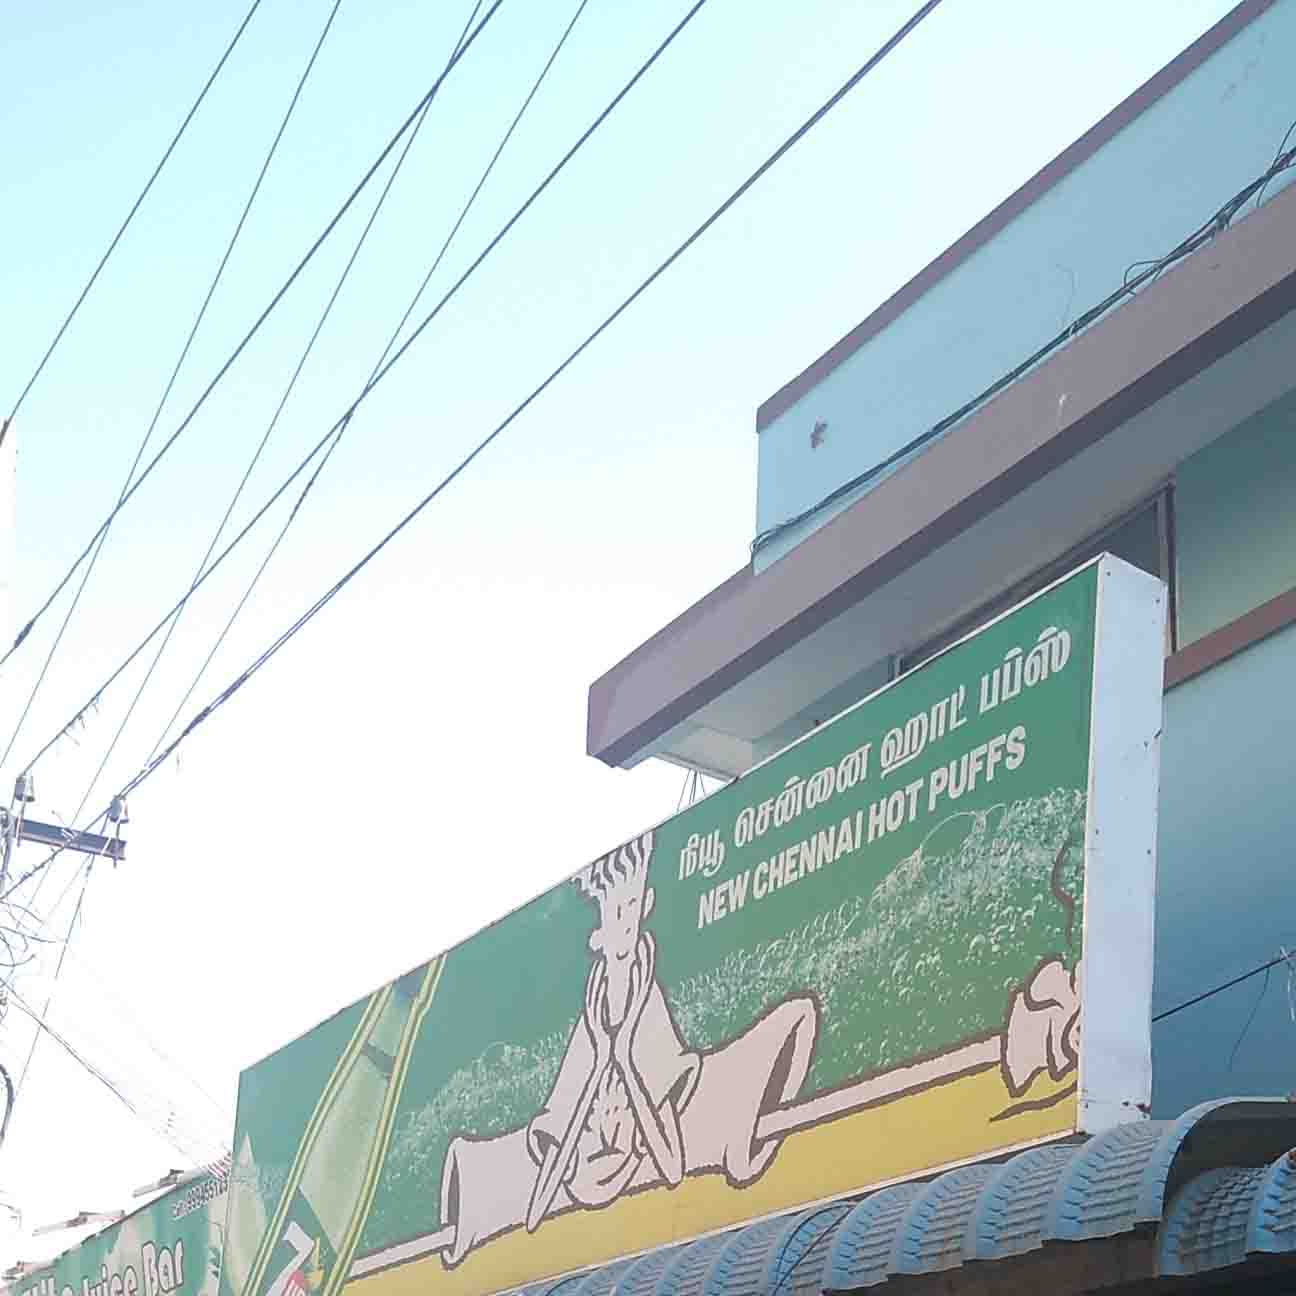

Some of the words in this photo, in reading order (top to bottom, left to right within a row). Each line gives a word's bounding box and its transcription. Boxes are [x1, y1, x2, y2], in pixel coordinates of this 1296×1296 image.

[698, 873, 752, 928] NEW
[752, 810, 864, 900] CHENNAI
[868, 779, 924, 843] HOT
[927, 726, 1026, 812] PUFFS
[734, 743, 872, 848] சென்னை
[880, 684, 967, 778] ஹாட்
[979, 626, 1071, 713] பப்ஸ்
